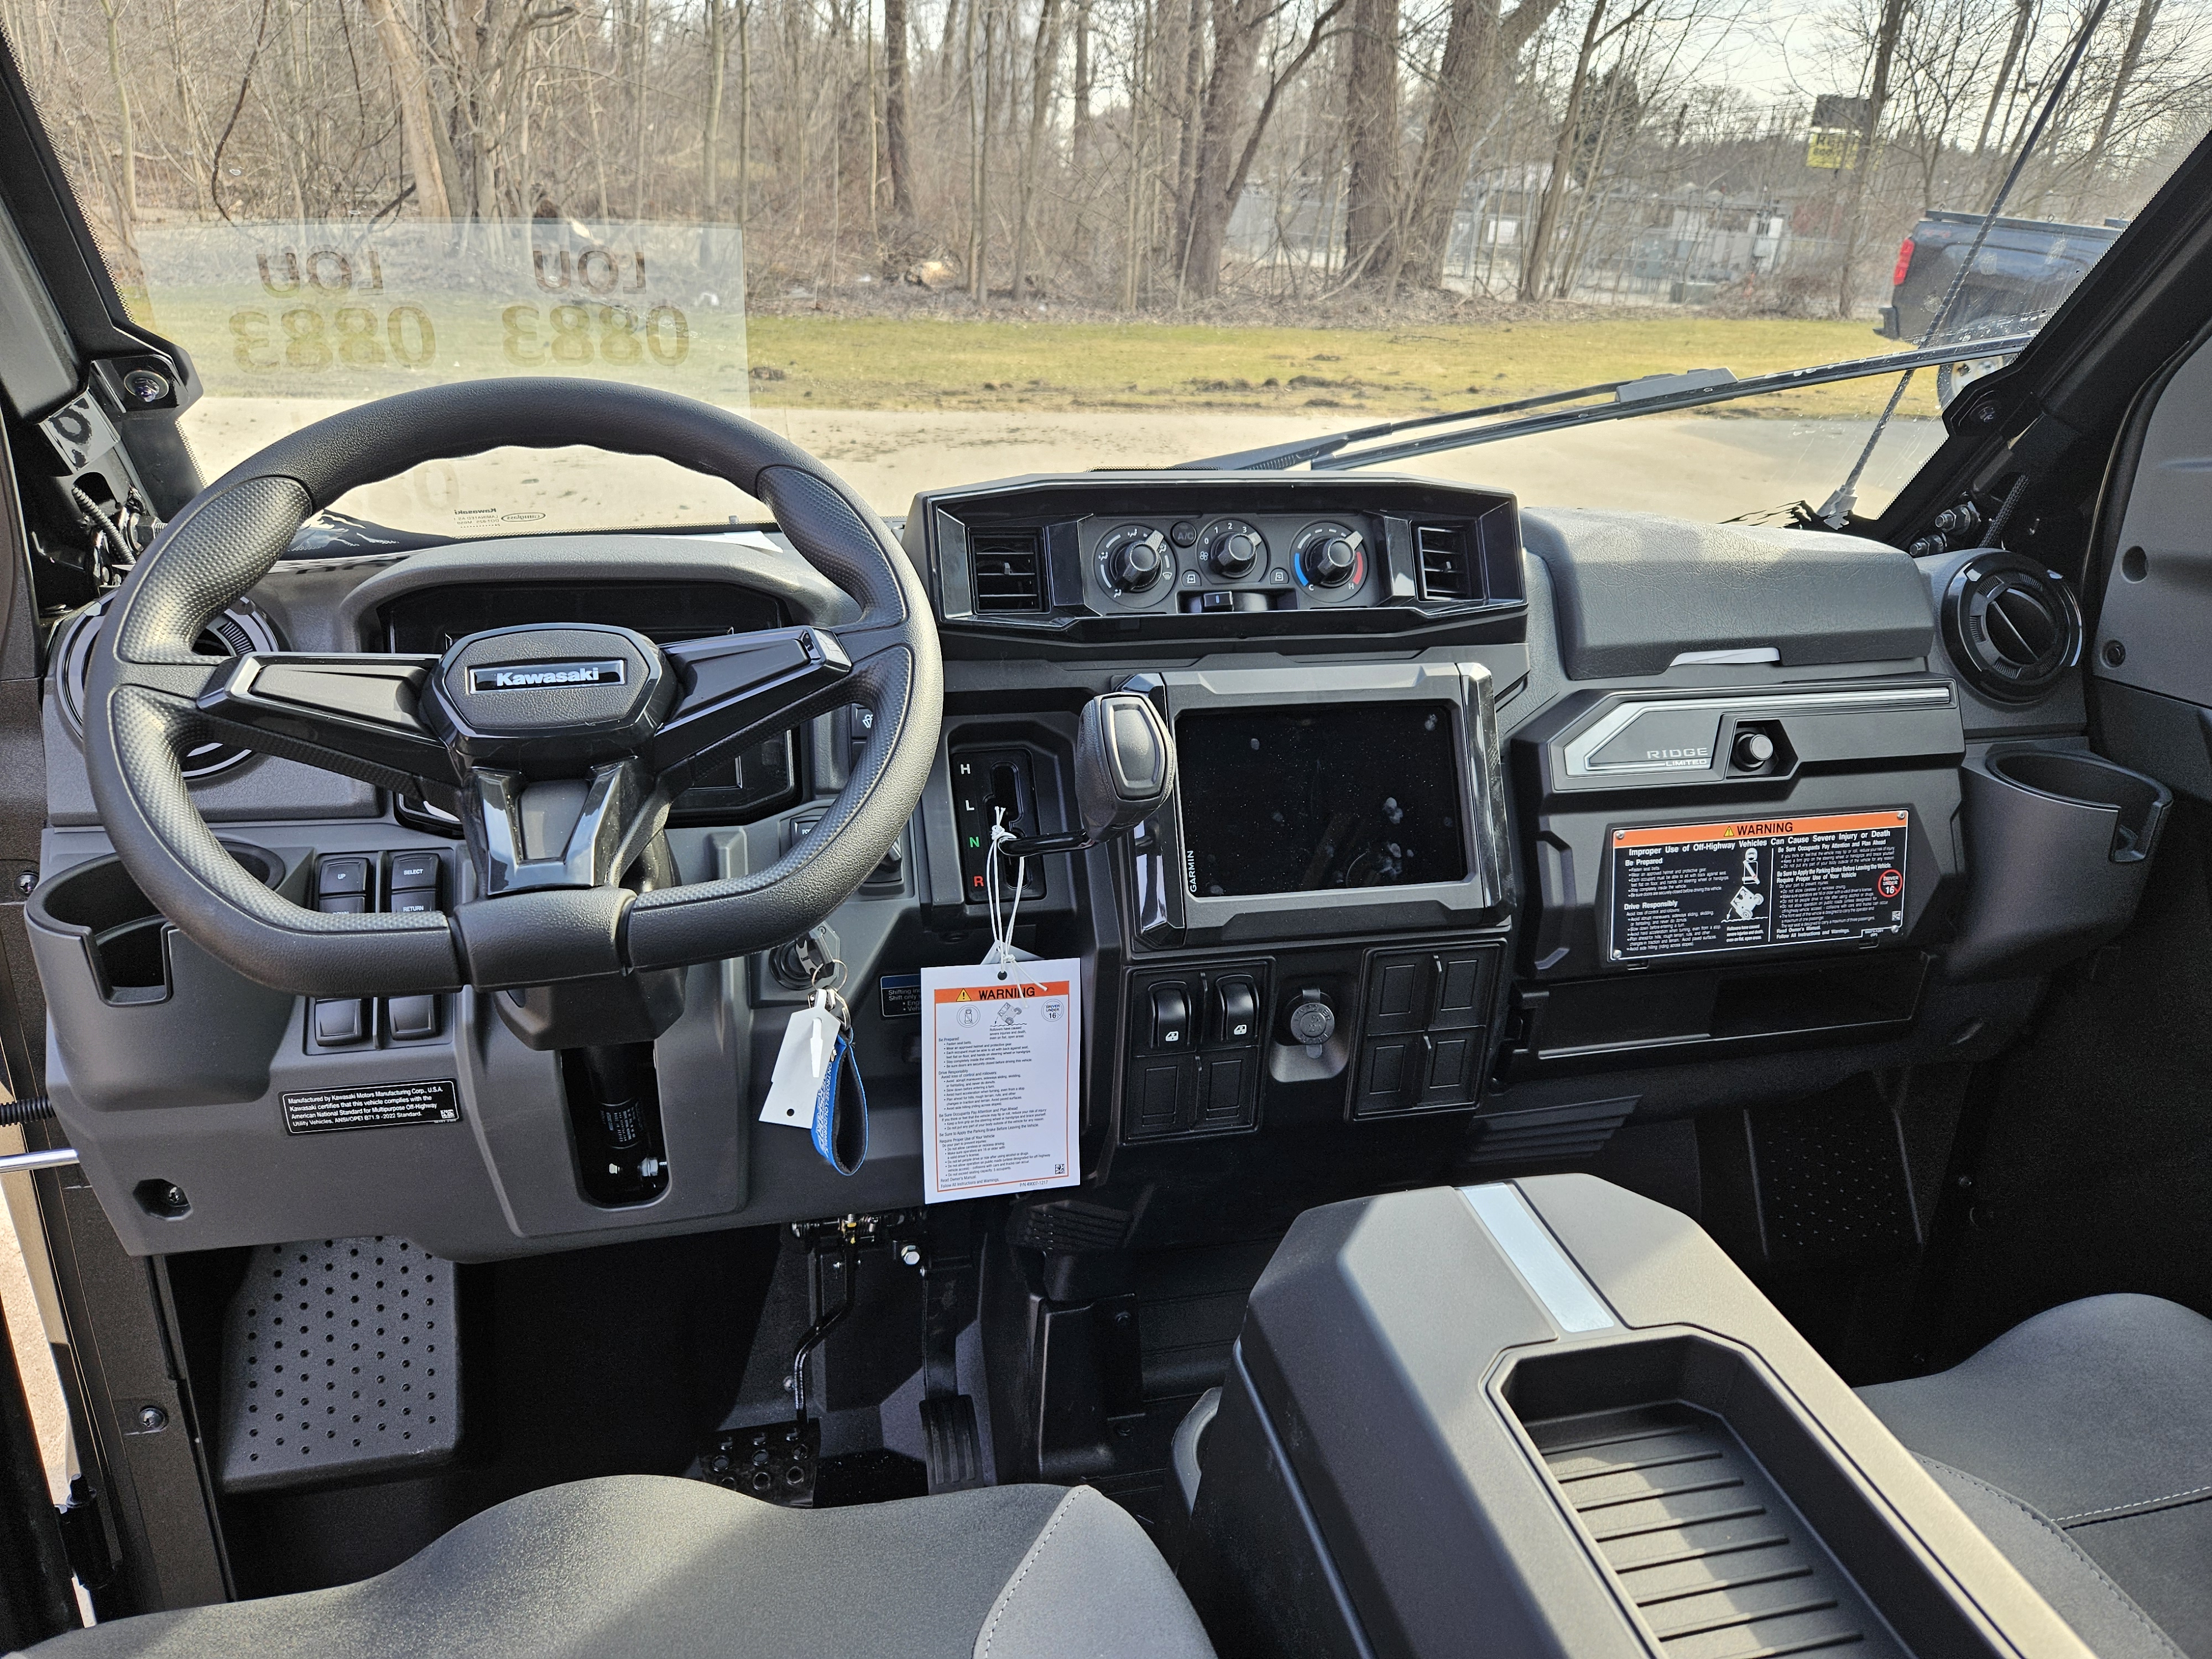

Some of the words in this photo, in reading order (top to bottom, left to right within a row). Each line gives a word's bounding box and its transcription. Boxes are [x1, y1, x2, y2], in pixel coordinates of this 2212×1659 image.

[1177, 532, 1194, 540] A/C
[497, 667, 599, 686] Kawasaki
[1647, 748, 1708, 759] RIDGE
[961, 764, 971, 774] H
[965, 800, 974, 811] L
[1736, 822, 1793, 836] WARNING
[969, 837, 979, 847] N
[1629, 848, 1661, 857] Improper
[1693, 842, 1735, 851] Off-Highway
[1739, 839, 1767, 848] Vehicles
[1839, 833, 1857, 841] Injury
[1871, 830, 1890, 838] Death
[1187, 851, 1197, 893] GARMIN
[974, 876, 984, 887] R
[1885, 886, 1895, 894] 16
[1642, 900, 1678, 909] Responsibly
[979, 987, 1035, 1000] WARNING
